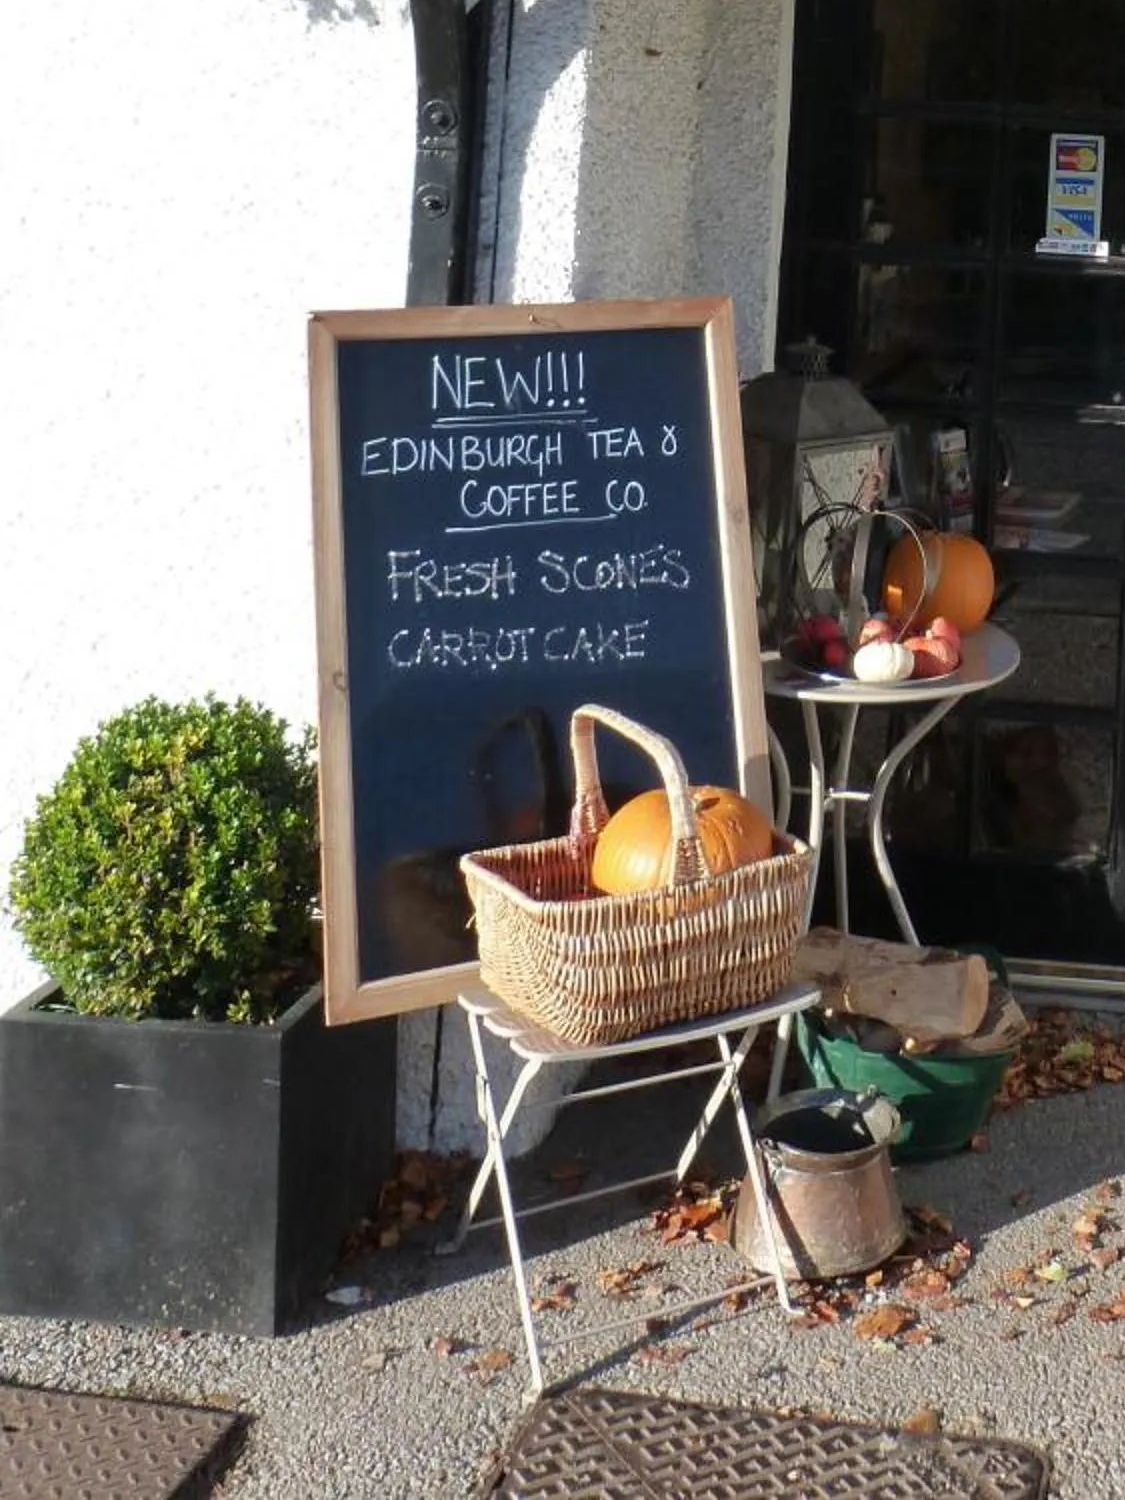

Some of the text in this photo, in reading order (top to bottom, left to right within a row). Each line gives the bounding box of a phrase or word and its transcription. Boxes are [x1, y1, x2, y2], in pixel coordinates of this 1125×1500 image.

[431, 351, 586, 409] NEW!!!
[361, 432, 563, 478] EDINBURGH
[588, 427, 645, 460] TEA
[460, 479, 580, 518] COFFEE
[387, 544, 691, 601] FRESH SCONES
[387, 619, 650, 670] CARROT CAKE
